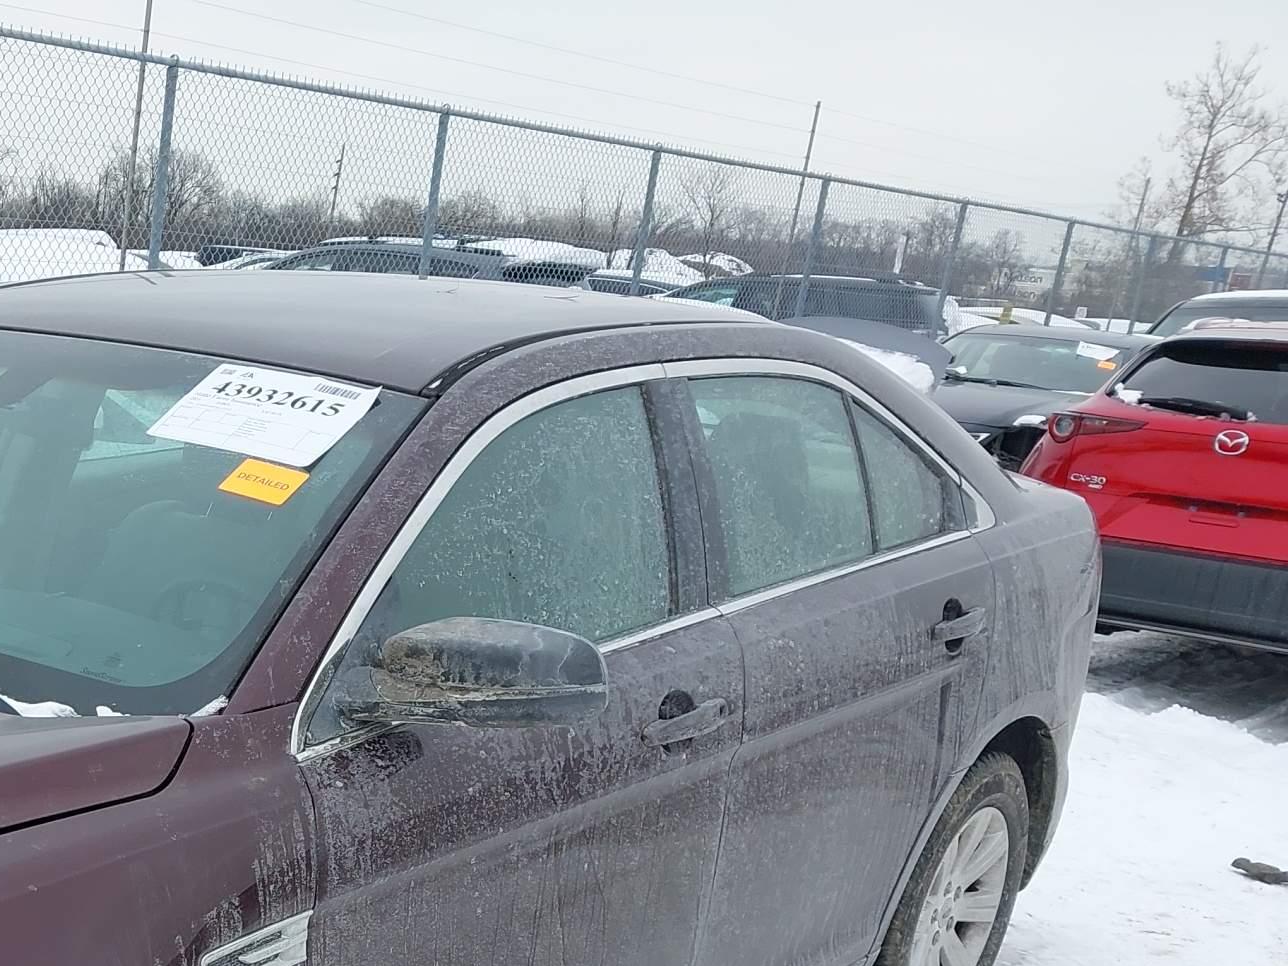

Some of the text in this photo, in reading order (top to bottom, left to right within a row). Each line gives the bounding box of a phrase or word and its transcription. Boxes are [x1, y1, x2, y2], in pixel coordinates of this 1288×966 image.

[211, 381, 345, 417] 43932615
[236, 471, 291, 491] DETAILED
[1070, 473, 1106, 485] CX-30
